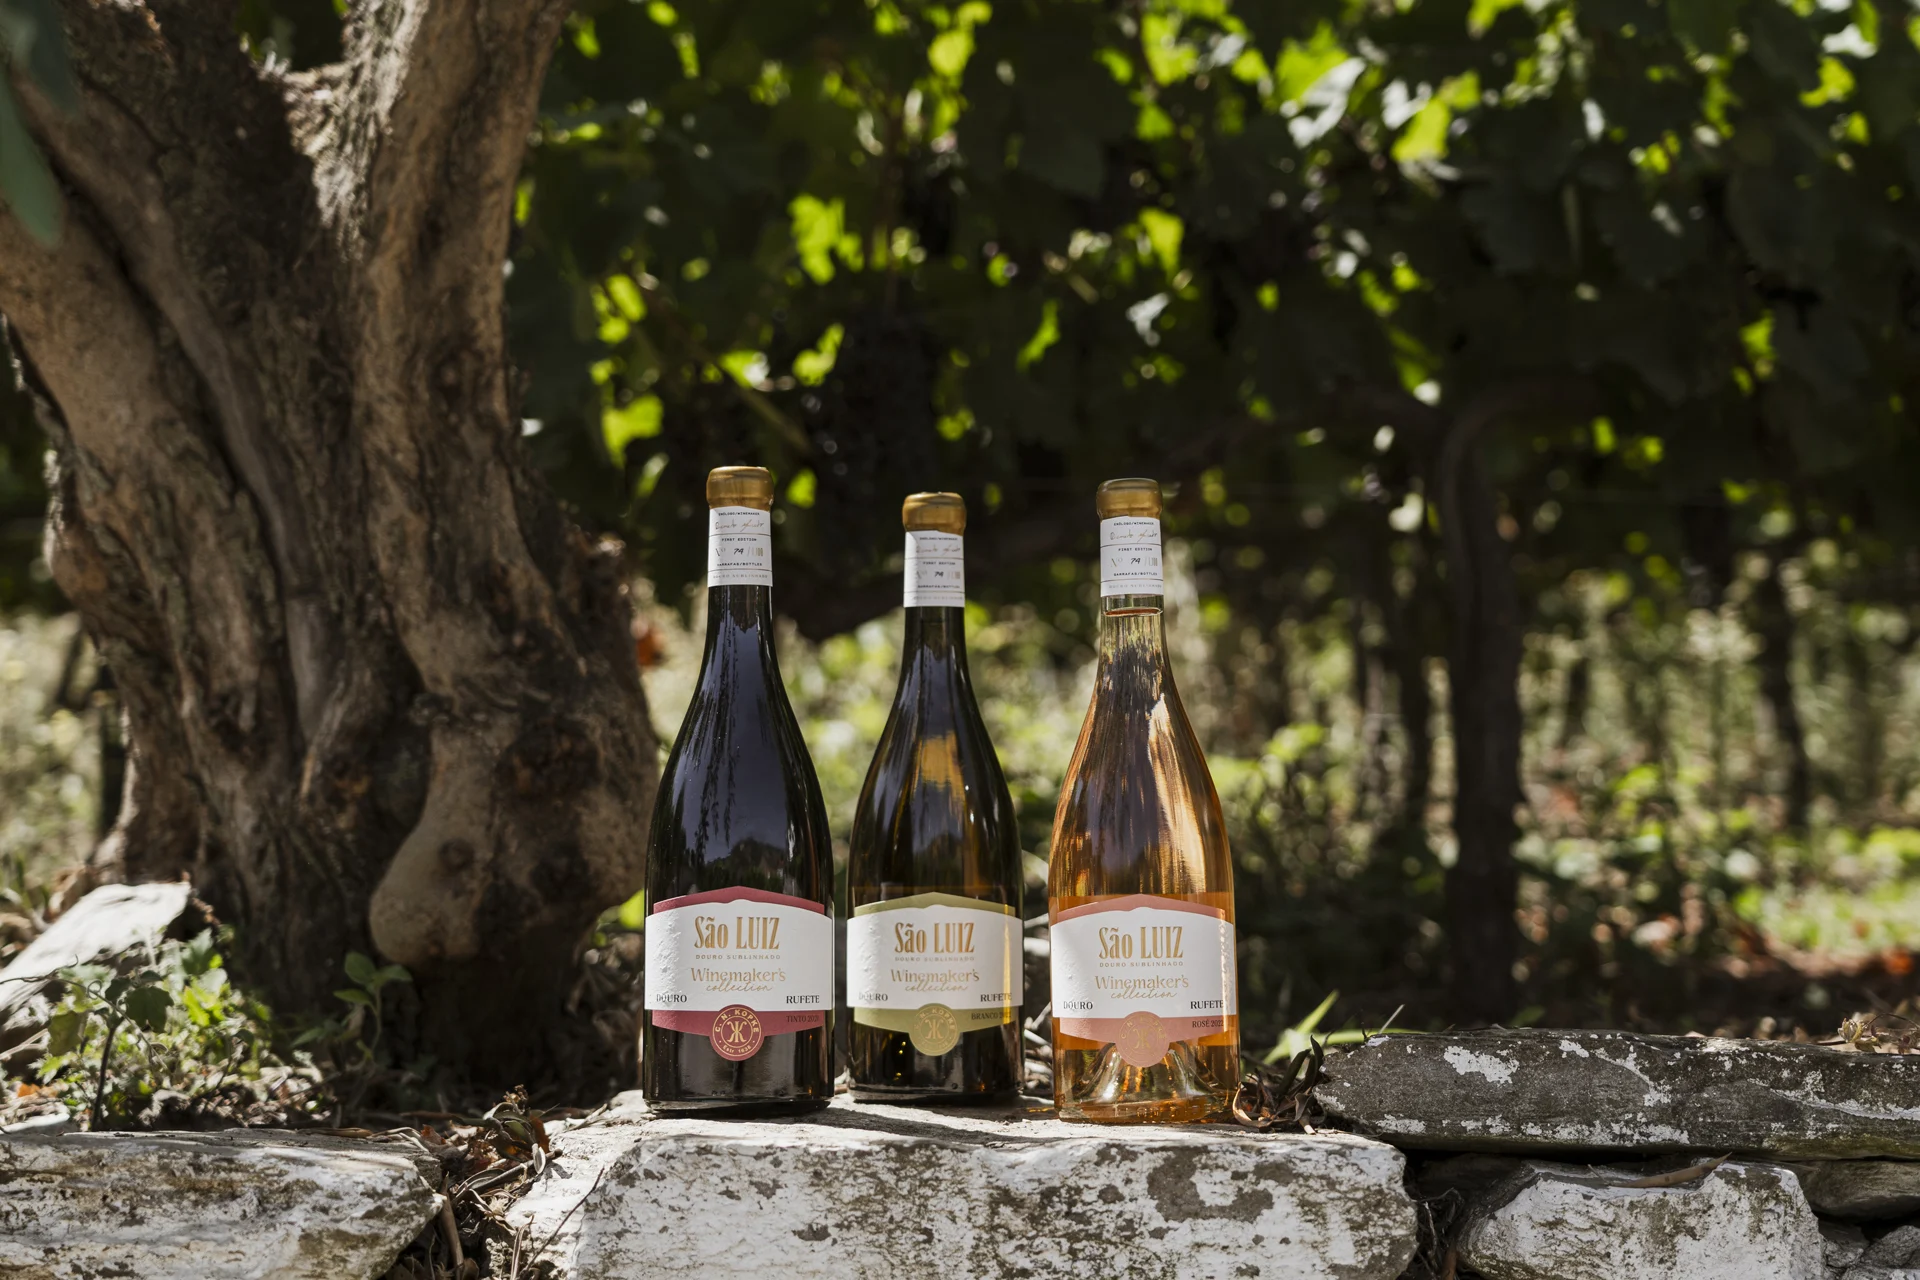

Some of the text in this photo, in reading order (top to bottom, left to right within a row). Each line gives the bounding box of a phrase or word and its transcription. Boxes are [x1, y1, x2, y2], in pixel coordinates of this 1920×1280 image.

[694, 916, 780, 950] São LUIZ
[894, 922, 975, 954] São LUIZ
[1098, 926, 1184, 960] São LUIZ
[691, 968, 786, 984] Winemaker's
[890, 968, 980, 984] Winemaker's
[1094, 974, 1189, 990] Winemaker's
[706, 978, 773, 992] collection
[905, 979, 968, 992] collection
[656, 994, 688, 1003] DOURO
[786, 995, 820, 1004] RUFETE
[980, 992, 1012, 1002] RUFETE
[1110, 986, 1178, 1000] collection
[1063, 1001, 1094, 1010] DOURO
[1190, 1000, 1224, 1010] RUFETE
[734, 1009, 760, 1033] KOPKE
[971, 1012, 998, 1020] BRANCO
[1192, 1020, 1224, 1028] ROSÉ 2022
